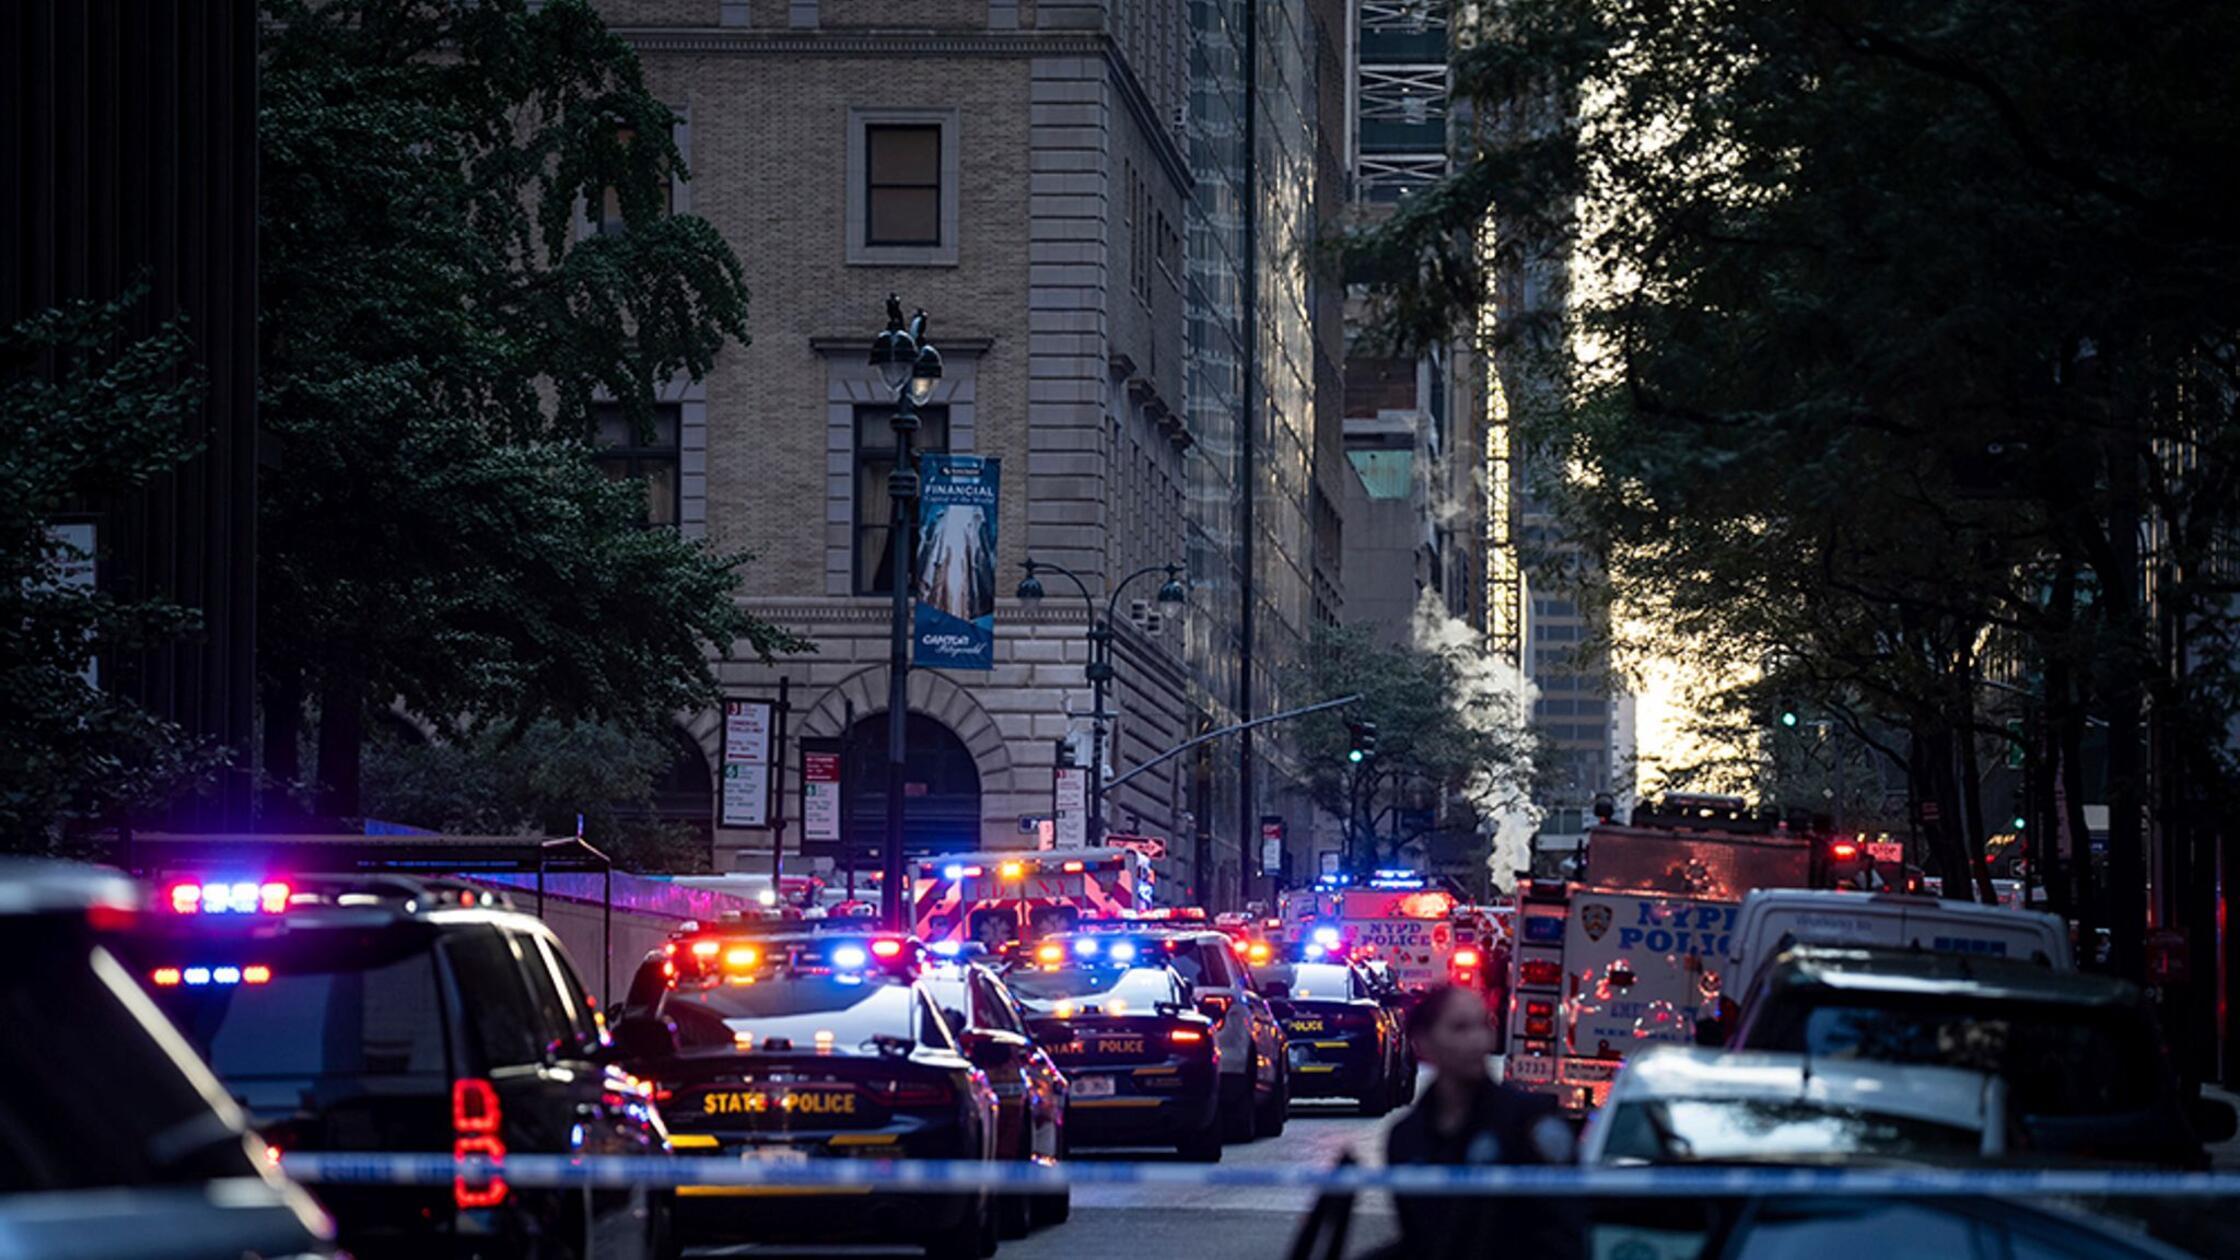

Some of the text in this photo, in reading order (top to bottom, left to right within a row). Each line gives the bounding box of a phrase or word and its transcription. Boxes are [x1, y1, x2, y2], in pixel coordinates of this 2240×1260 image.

[924, 484, 994, 497] FINANCIAL
[1370, 923, 1422, 934] NYPD
[1362, 934, 1431, 946] POLICE
[1098, 1040, 1144, 1053] POLICE
[704, 1092, 855, 1114] STATE POLICE
